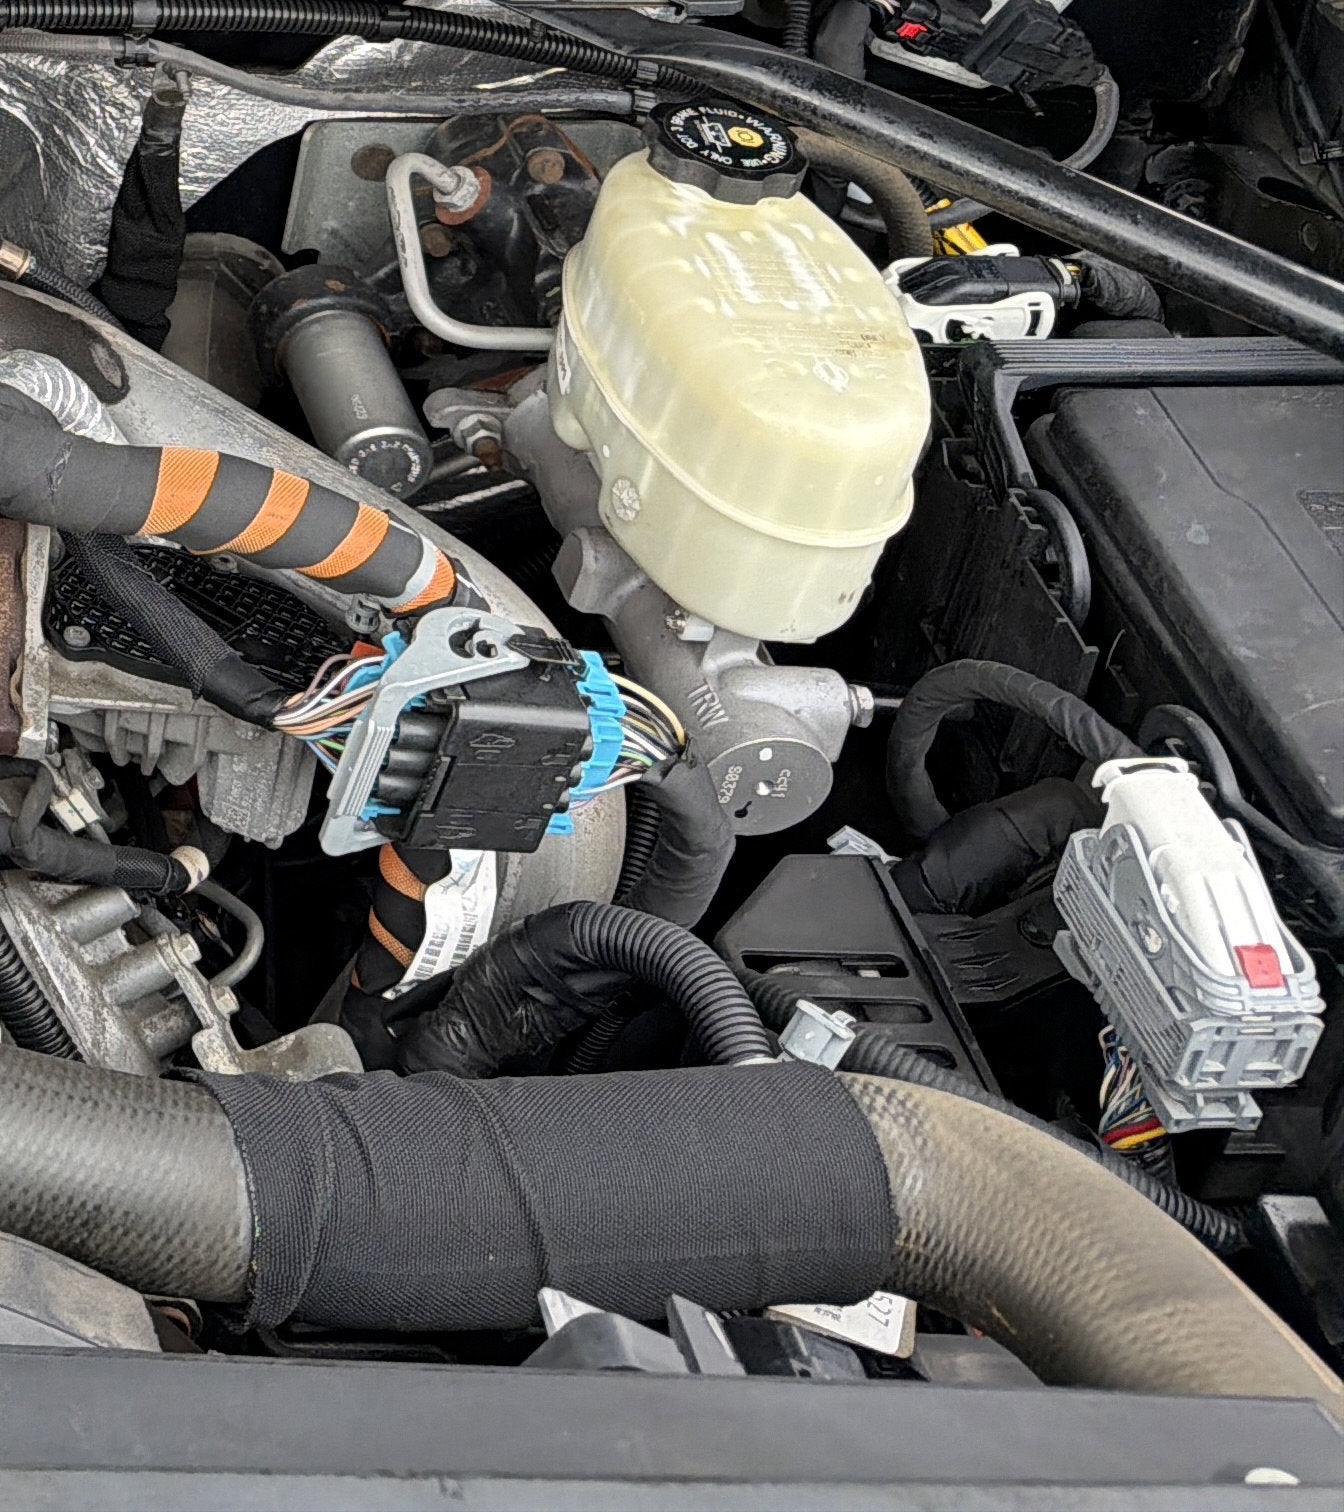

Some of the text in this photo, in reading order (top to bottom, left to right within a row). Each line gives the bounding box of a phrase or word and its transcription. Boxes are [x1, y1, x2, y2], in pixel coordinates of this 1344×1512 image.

[698, 106, 738, 119] FLUID
[677, 133, 699, 149] DOT
[746, 116, 787, 164] WARNING
[699, 149, 732, 165] ONLY
[687, 678, 730, 730] TRW
